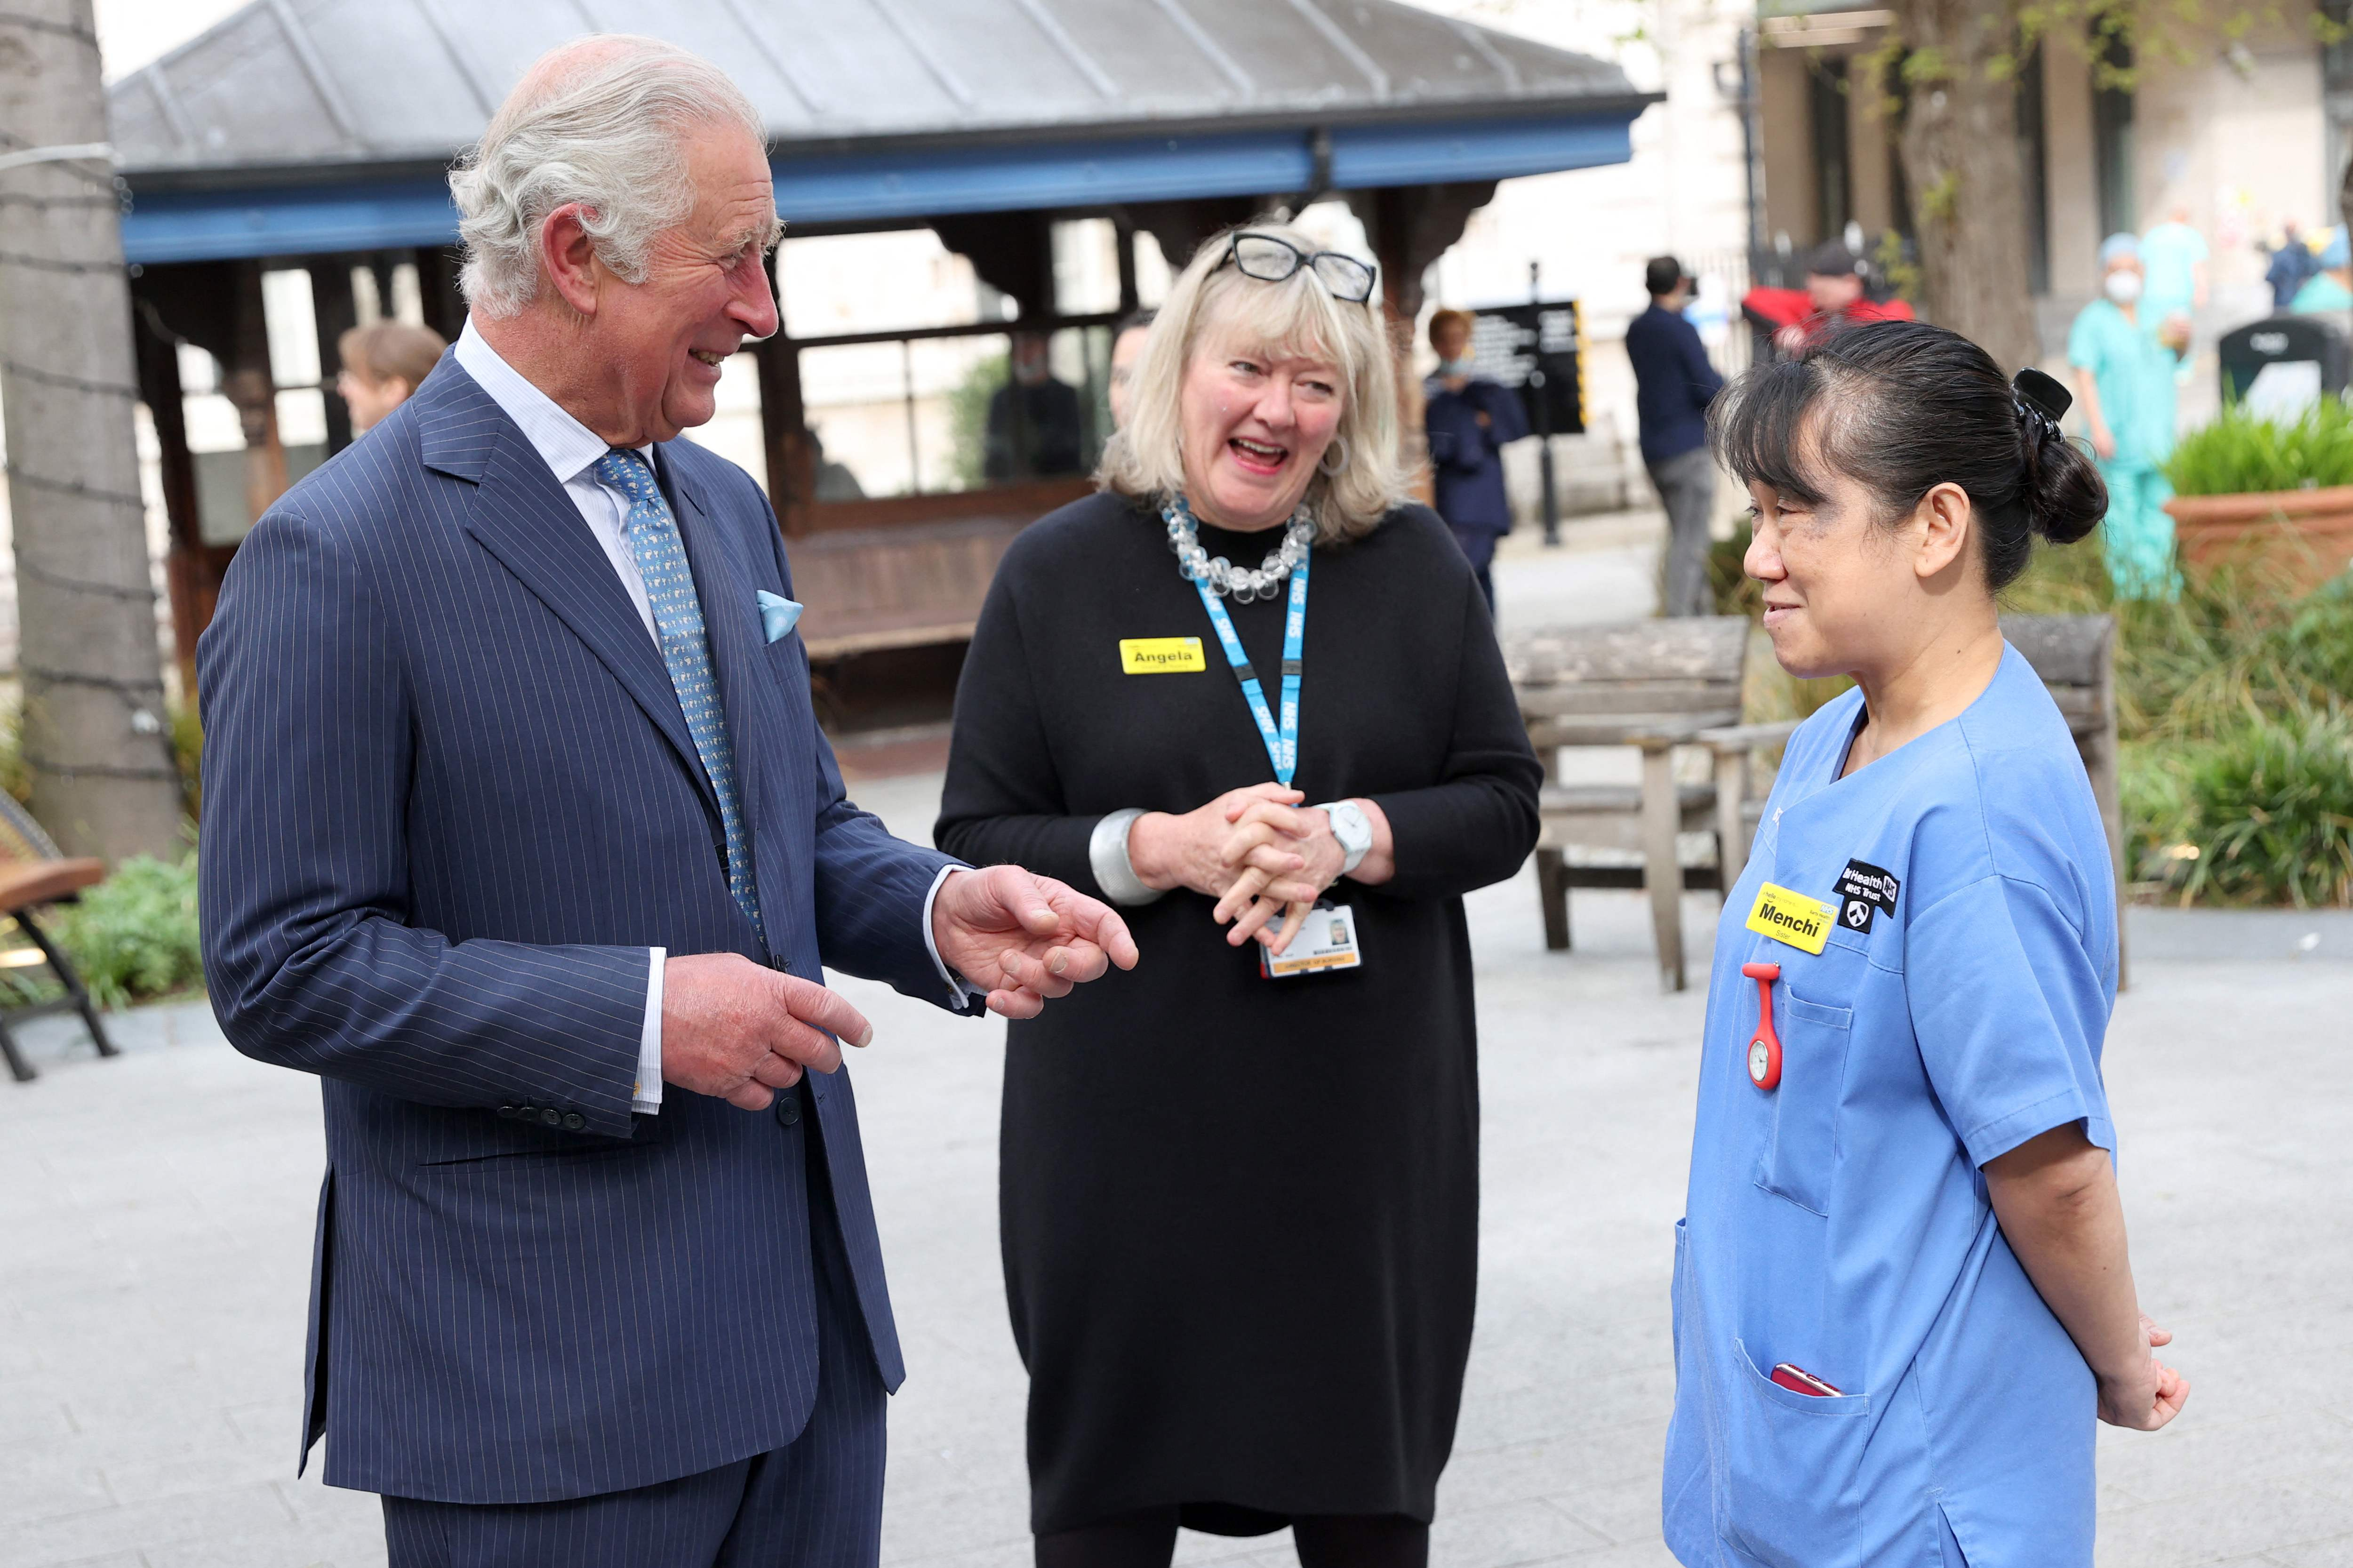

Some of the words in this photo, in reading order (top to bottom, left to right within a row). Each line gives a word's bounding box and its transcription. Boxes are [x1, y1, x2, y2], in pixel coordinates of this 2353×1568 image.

[1292, 577, 1306, 605] NHS
[1216, 617, 1238, 644] NHS
[1288, 611, 1303, 638] NHS
[1135, 651, 1193, 664] Angela
[1255, 706, 1276, 734] NHS
[1282, 701, 1297, 730] NHS
[1281, 738, 1296, 770] NHS
[1845, 883, 1861, 895] NHS
[1863, 888, 1881, 902] Trust
[1850, 870, 1882, 890] Health
[1759, 903, 1820, 937] Menchi
[1820, 904, 1833, 915] NHS
[1776, 930, 1790, 939] Sister
